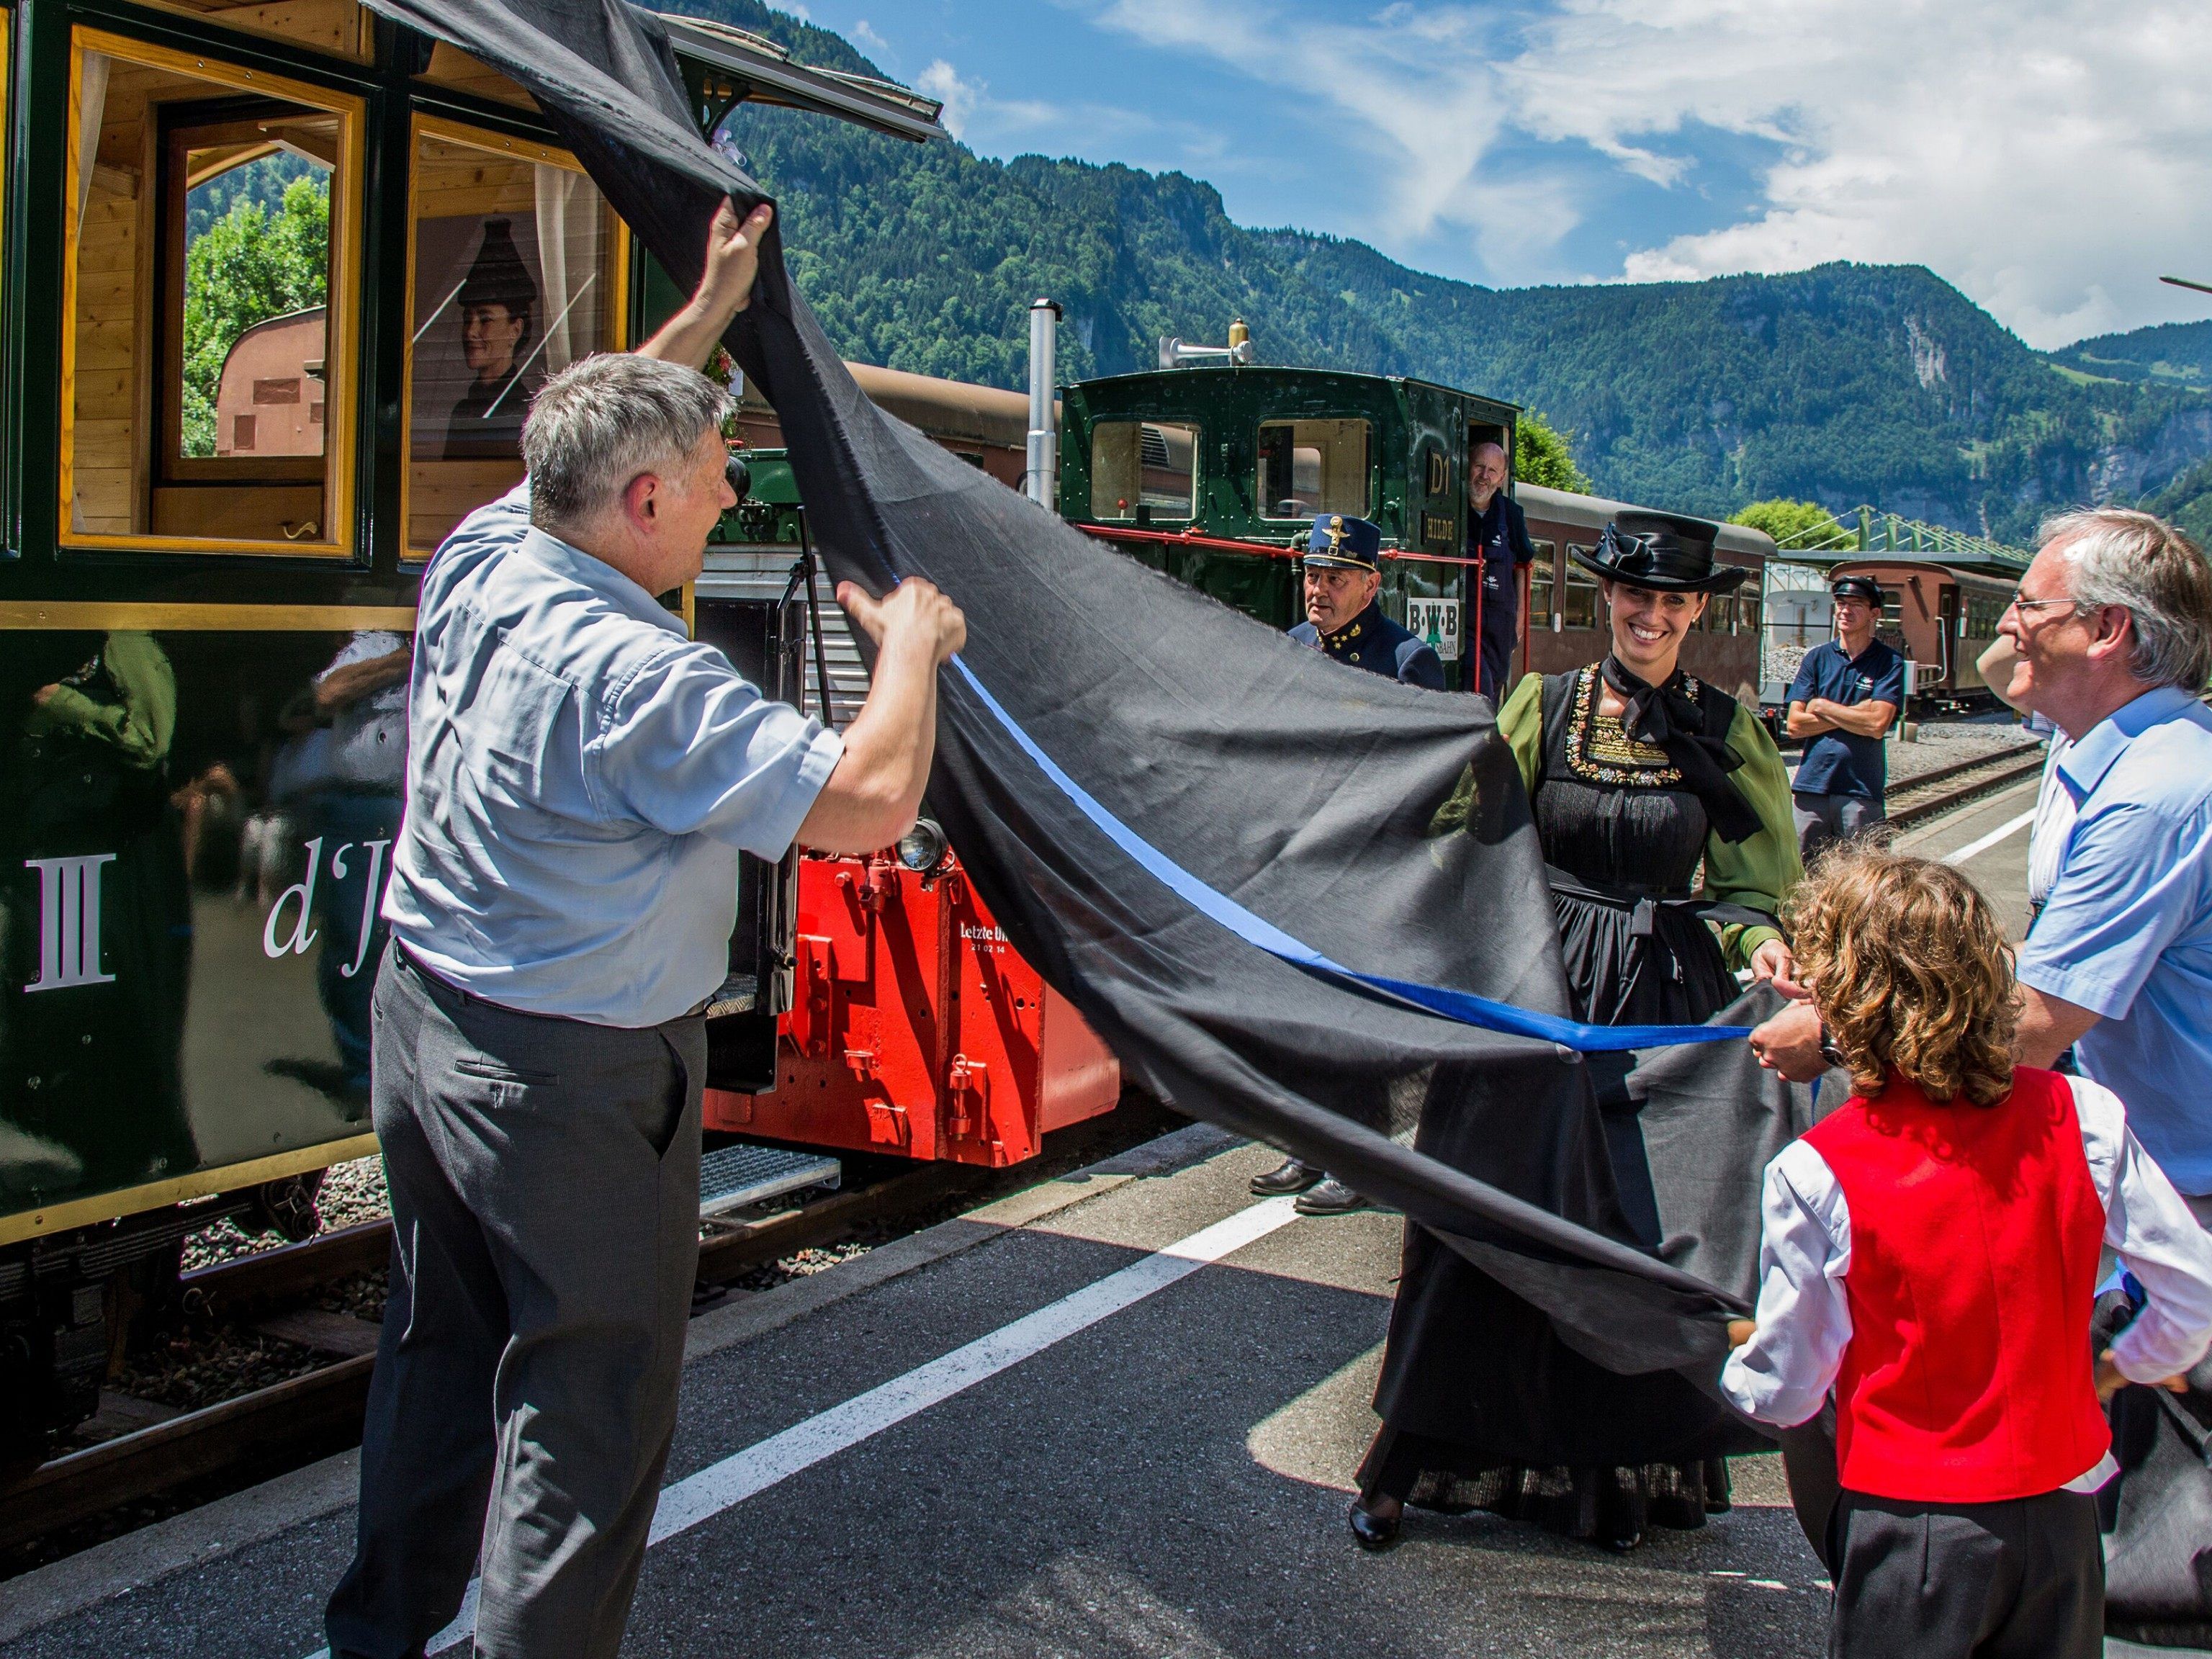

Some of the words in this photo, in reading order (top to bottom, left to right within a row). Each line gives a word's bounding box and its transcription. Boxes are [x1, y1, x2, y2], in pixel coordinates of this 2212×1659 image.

[1430, 453, 1450, 495] D1
[1427, 518, 1453, 540] HILDE
[264, 836, 392, 978] d'J
[960, 920, 993, 940] Letzte
[994, 925, 1009, 943] Un
